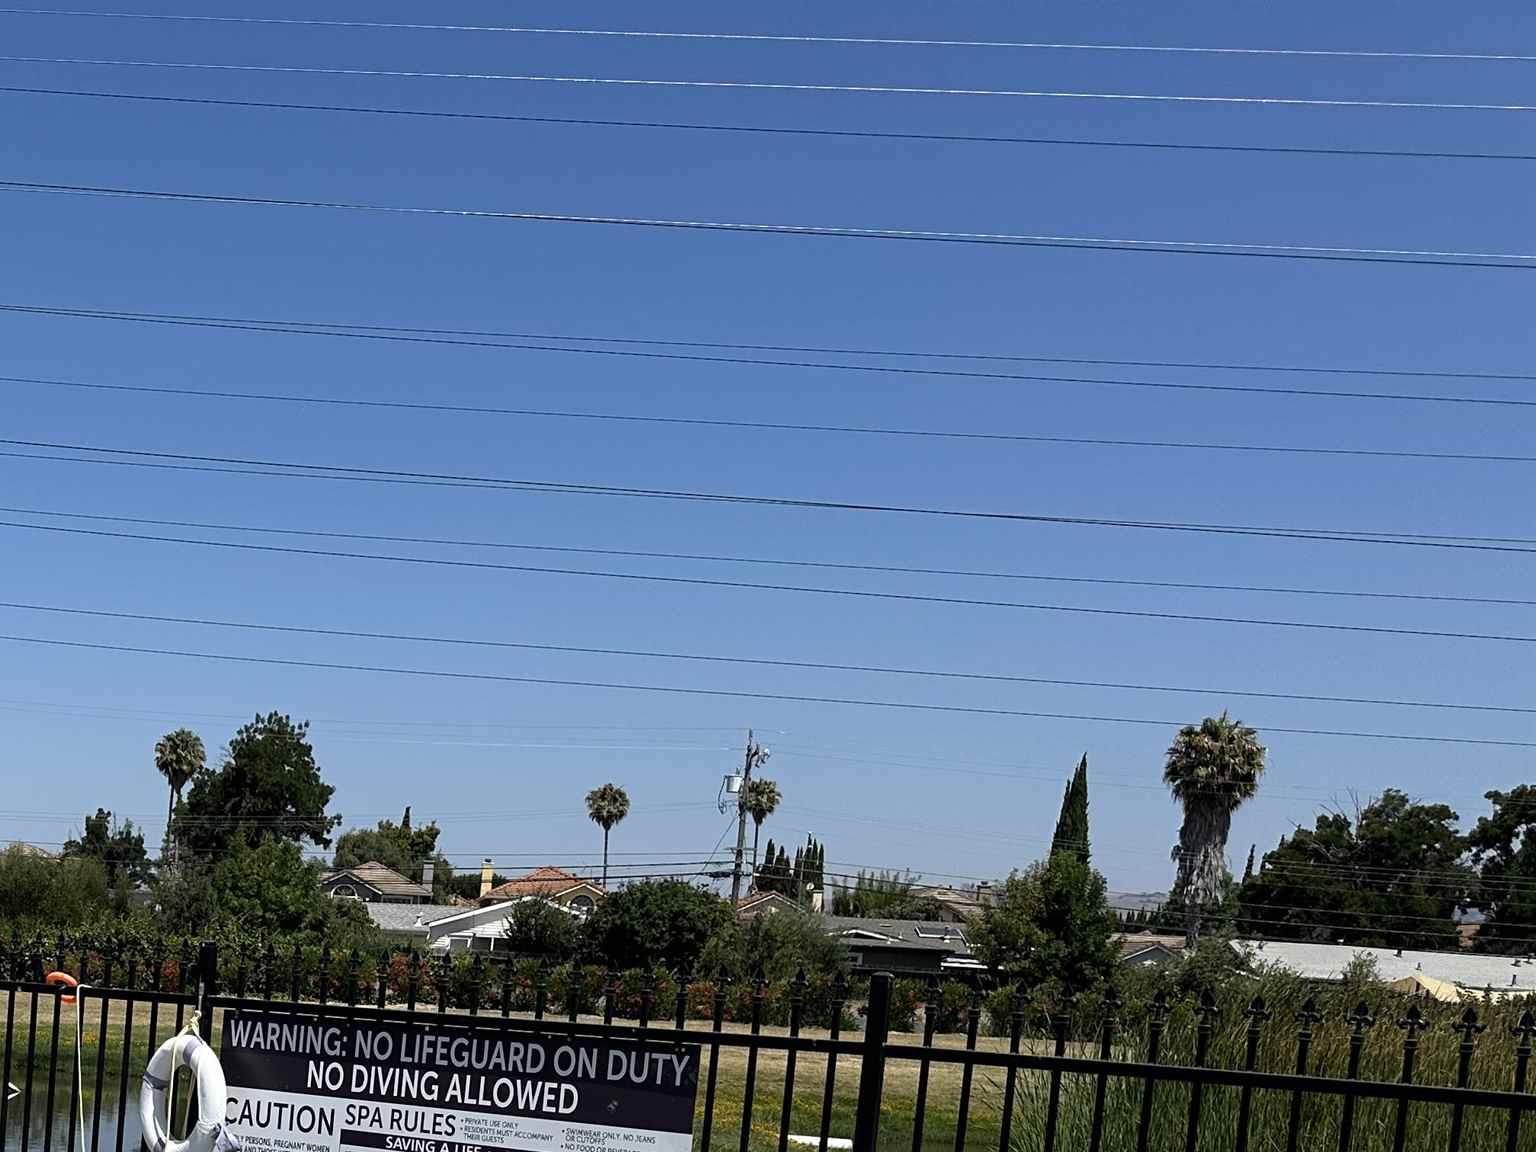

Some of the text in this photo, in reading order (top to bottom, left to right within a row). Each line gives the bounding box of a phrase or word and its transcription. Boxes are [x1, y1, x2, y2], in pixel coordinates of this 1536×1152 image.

[228, 1019, 690, 1086] WARNING: NO LIFEGUARD ON DUTY
[306, 1060, 580, 1114] NO DIVING ALLOWED
[225, 1097, 335, 1135] CAUTION
[344, 1103, 456, 1136] SPA RULES
[464, 1117, 488, 1126] PRIVATE
[502, 1121, 518, 1129] ONLY
[463, 1133, 504, 1143] THEIR GUESTS
[464, 1125, 495, 1135] RESIDENTS
[496, 1129, 513, 1137] MUST
[566, 1128, 600, 1138] SWIMWEAR
[635, 1135, 656, 1144] JEANS
[385, 1136, 435, 1152] SAVING
[564, 1143, 575, 1151] NO
[576, 1144, 595, 1152] FOOD
[576, 1136, 605, 1145] CUTOFFS
